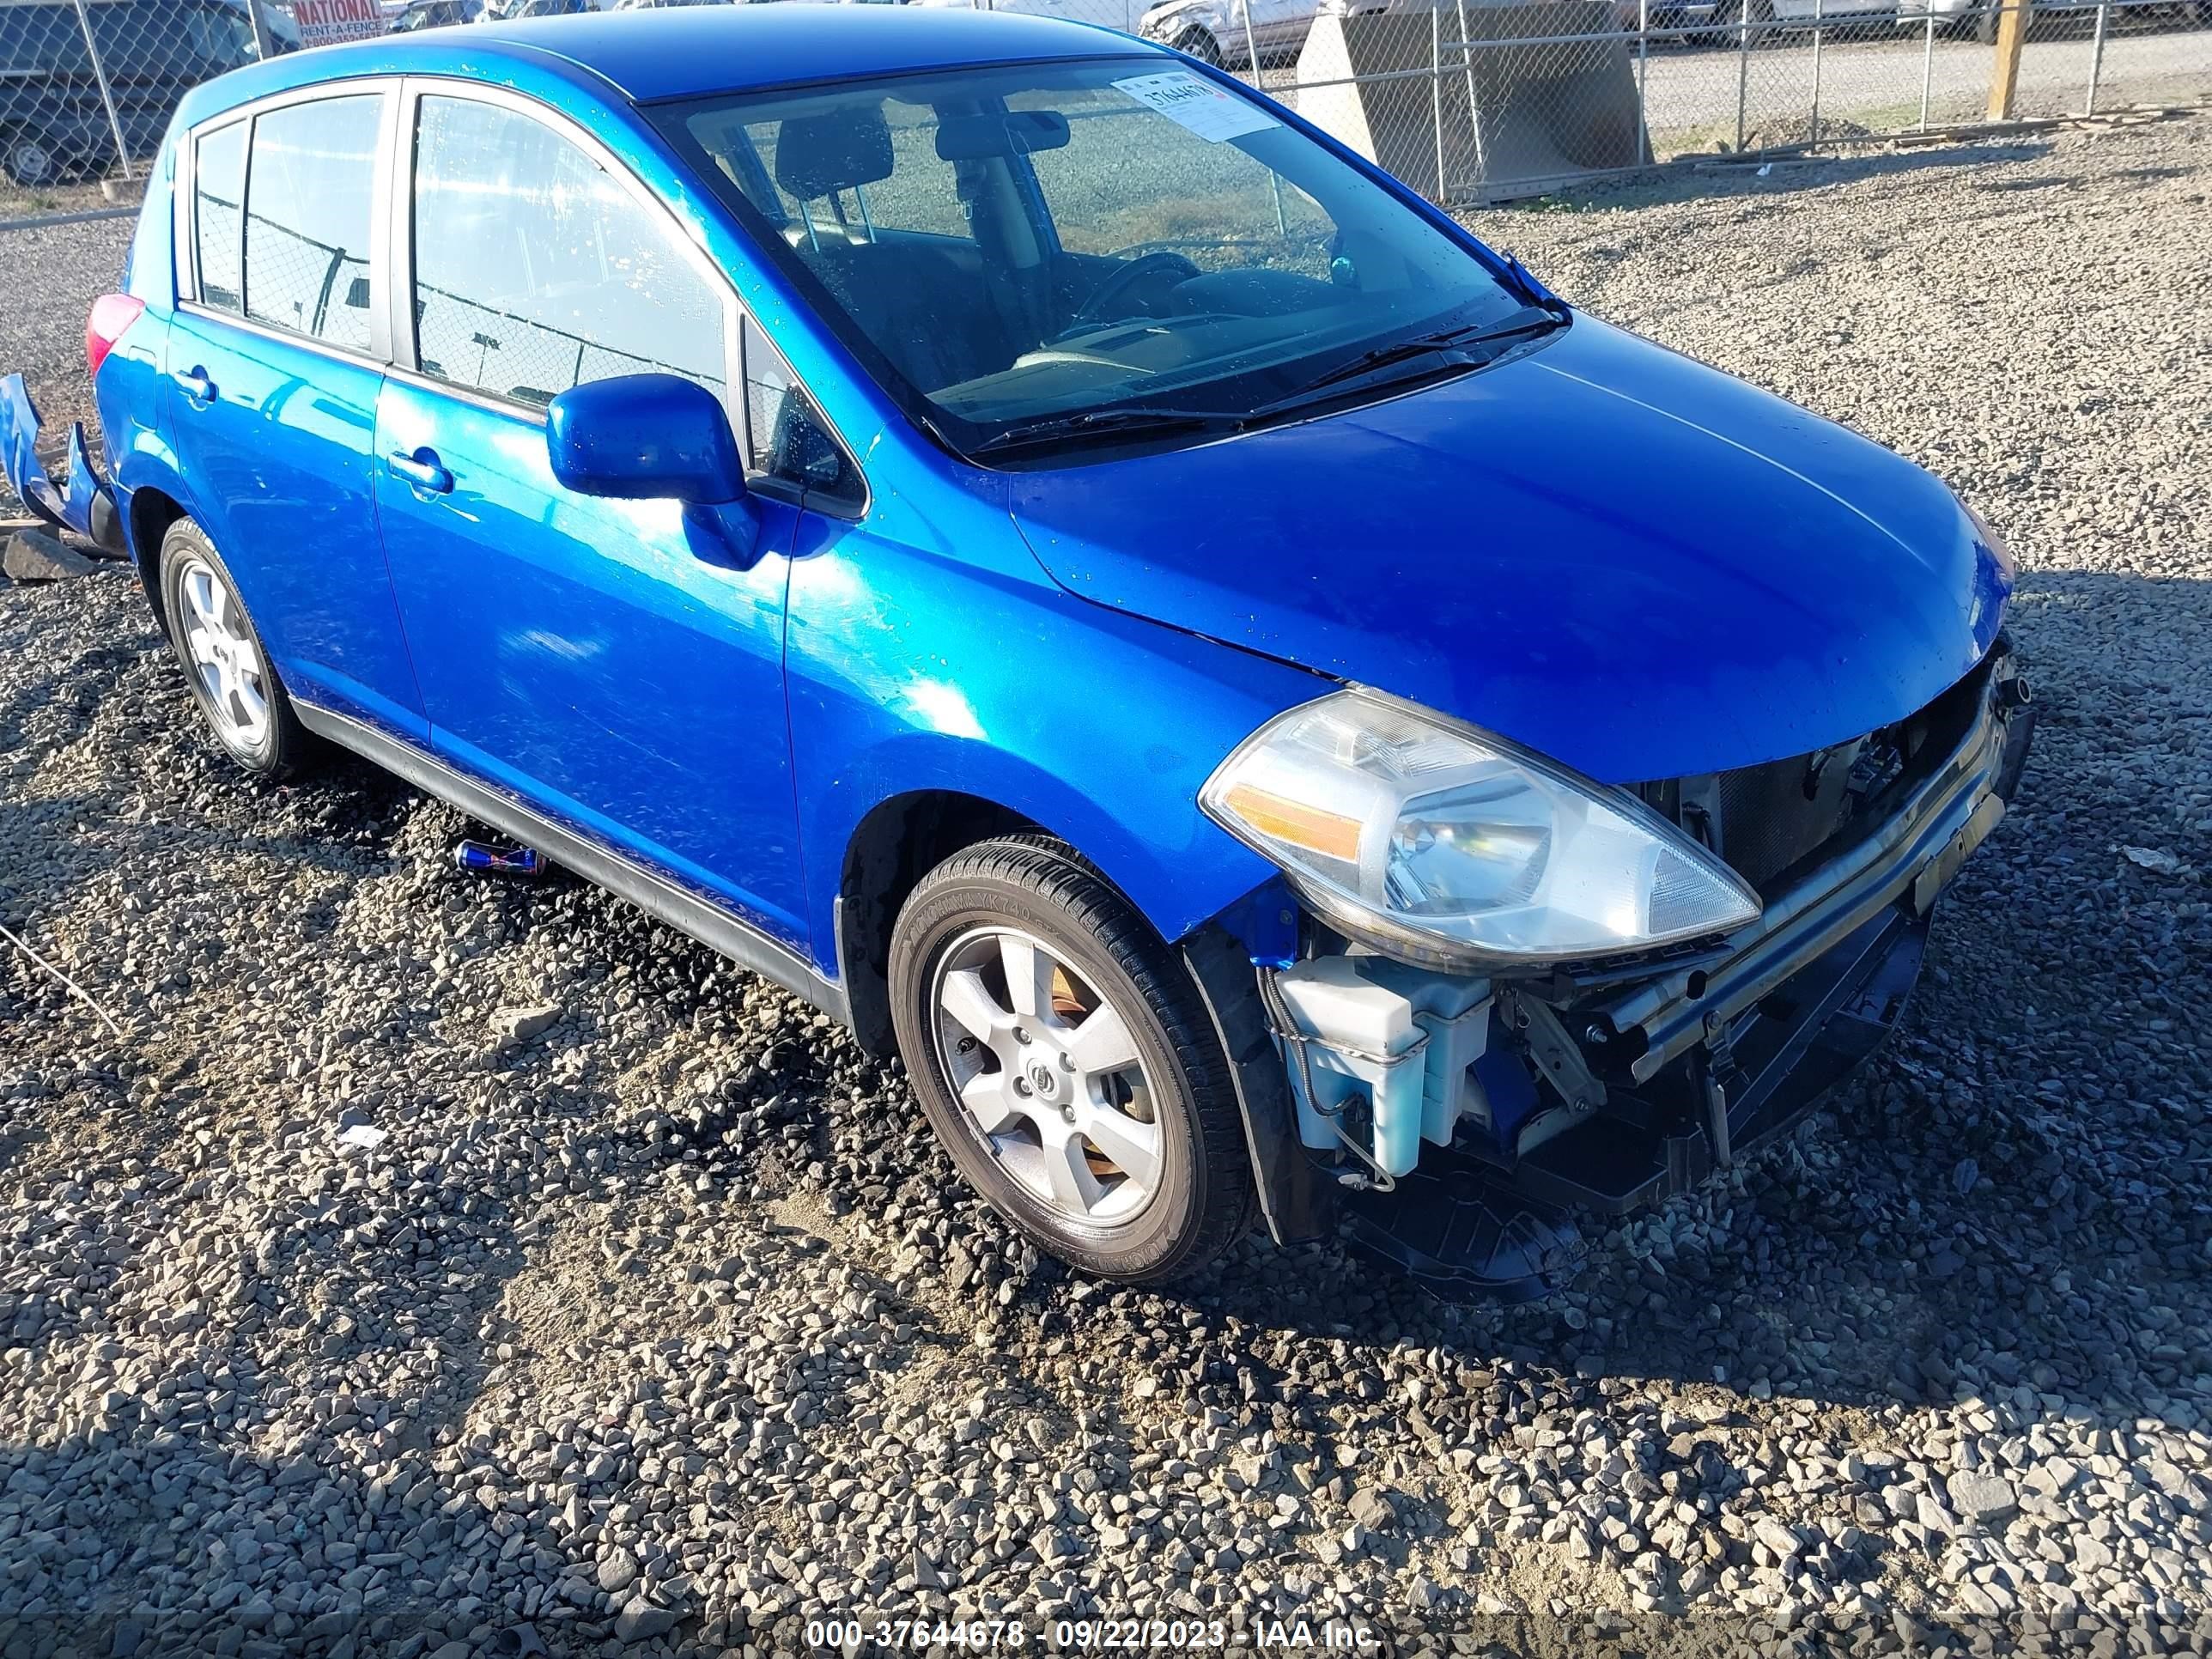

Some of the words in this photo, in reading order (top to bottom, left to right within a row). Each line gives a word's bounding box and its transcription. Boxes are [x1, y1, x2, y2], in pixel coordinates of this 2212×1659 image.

[295, 0, 380, 25] NATIONAL
[301, 21, 382, 36] RENT-A-FENCE
[1144, 85, 1214, 106] 37644678
